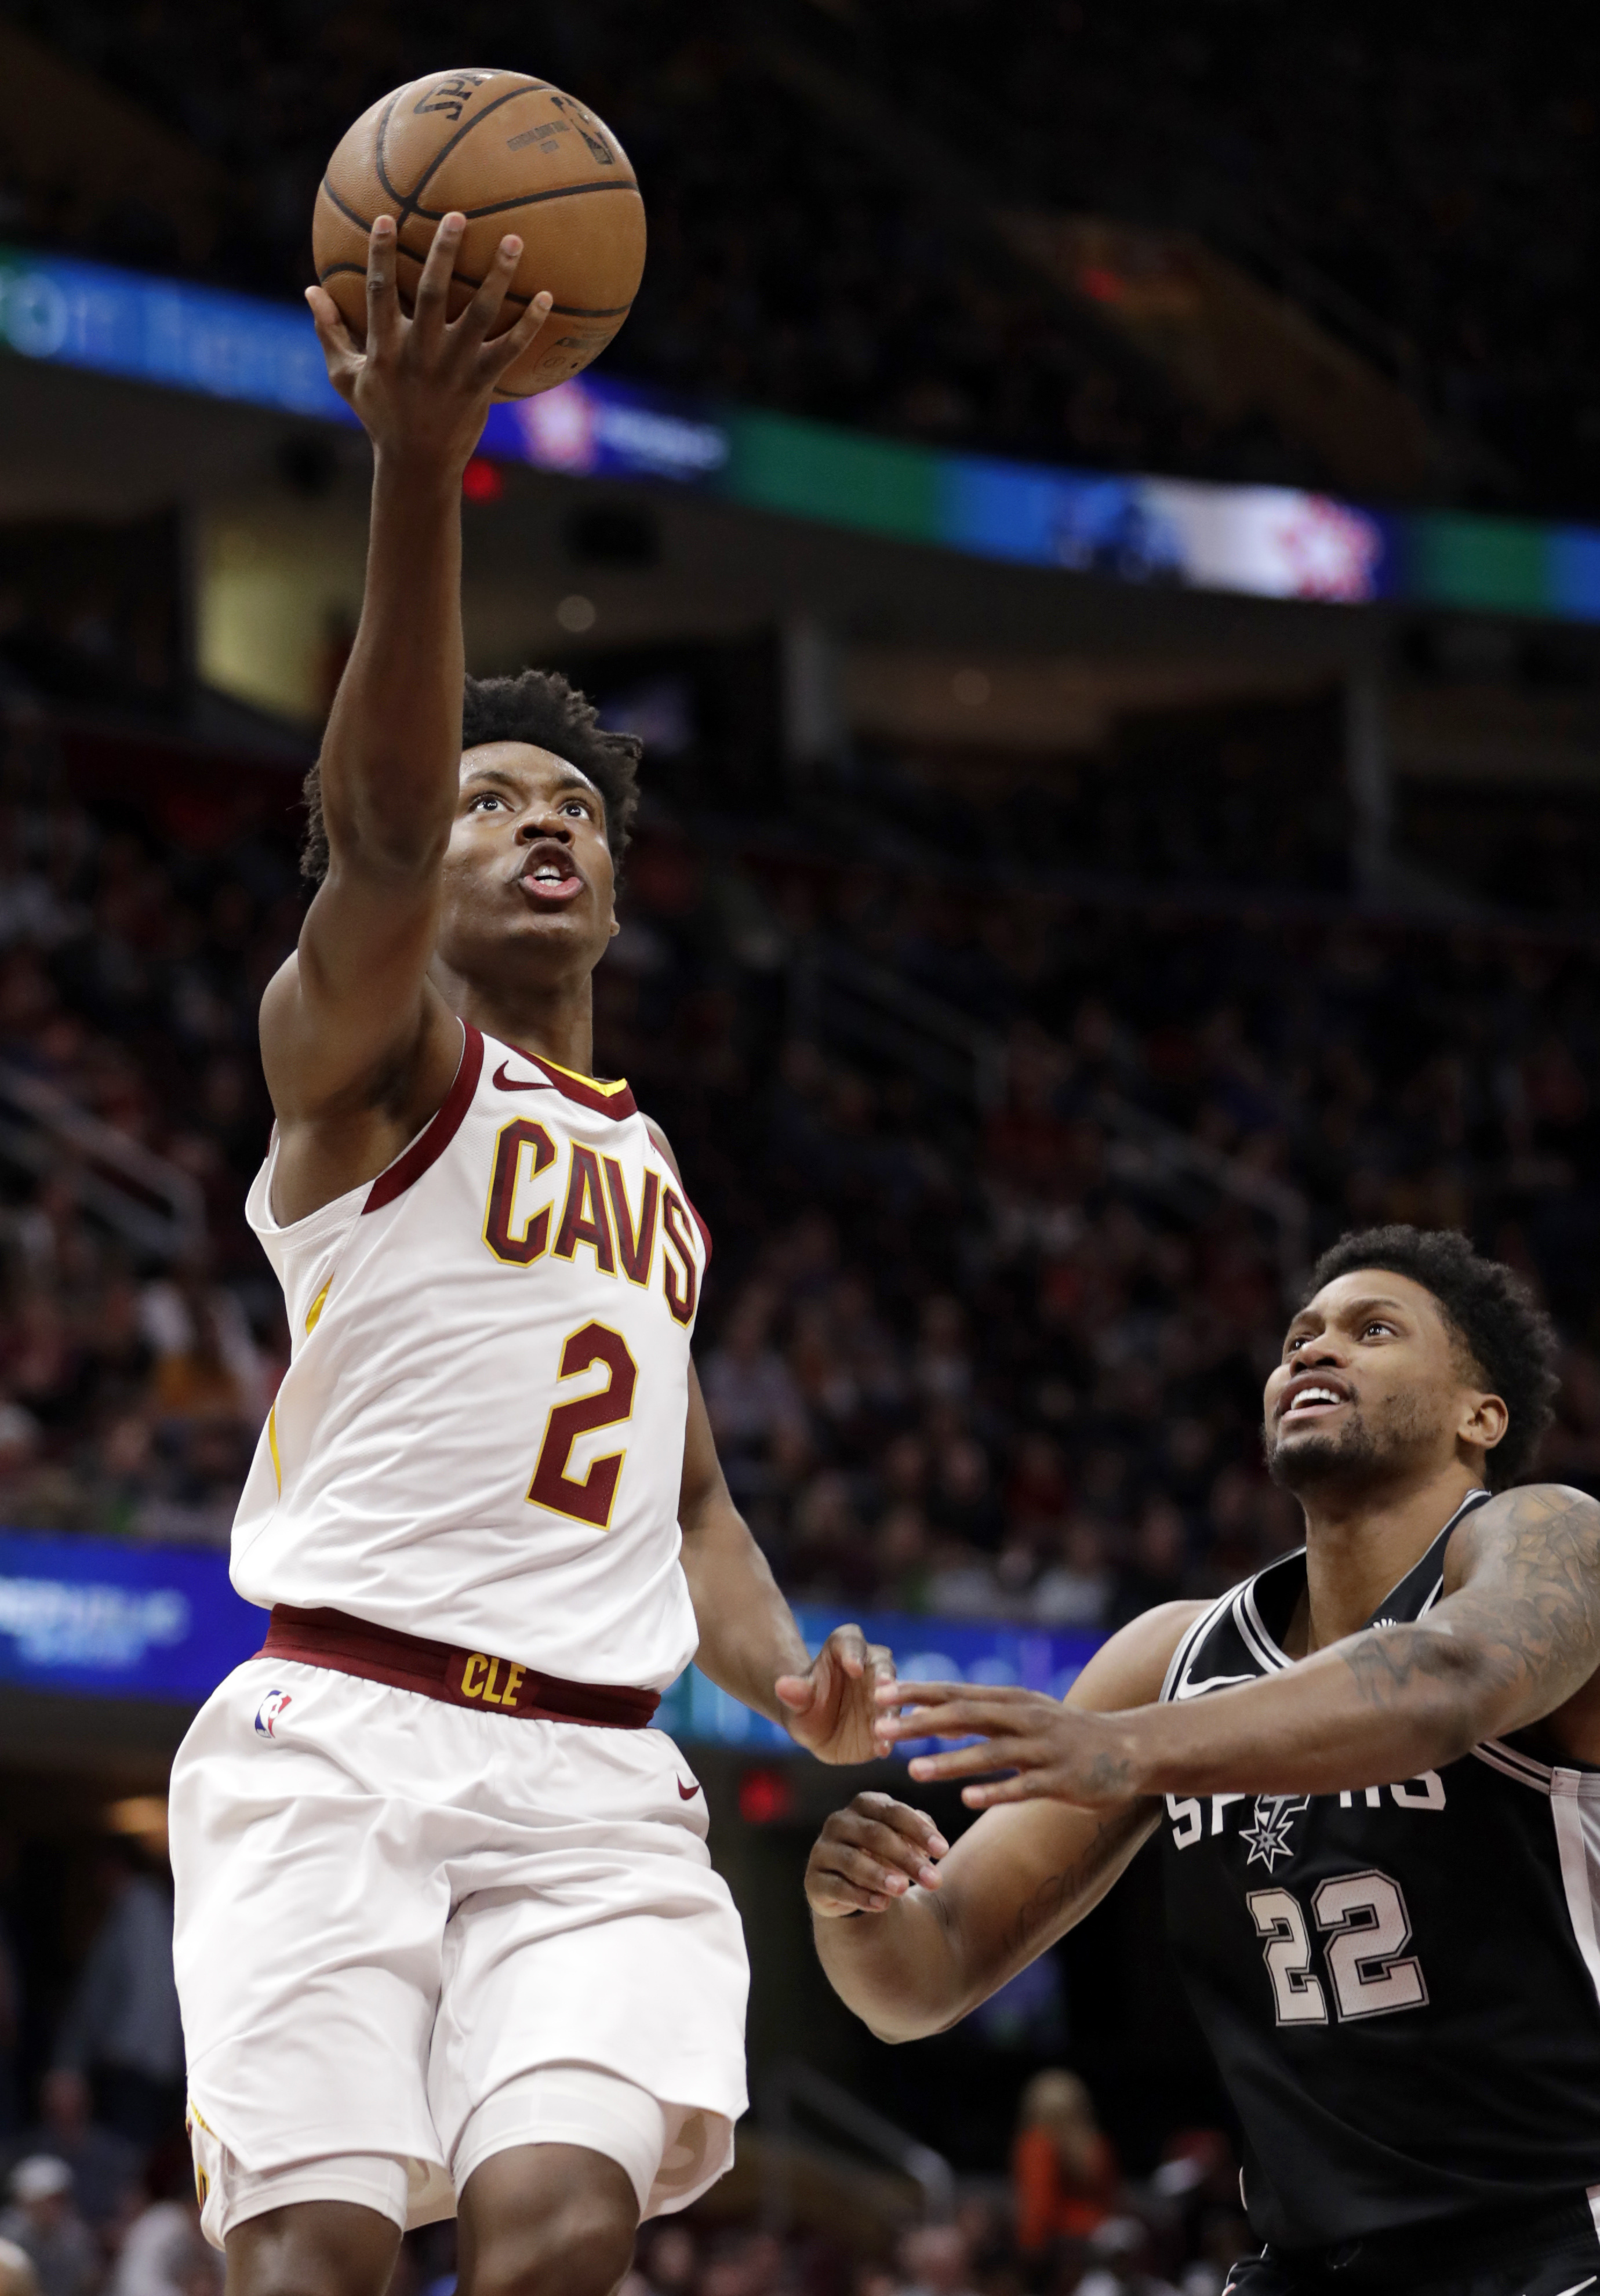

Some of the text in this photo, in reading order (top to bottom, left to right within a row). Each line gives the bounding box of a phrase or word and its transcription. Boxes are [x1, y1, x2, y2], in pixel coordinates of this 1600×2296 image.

[481, 1116, 697, 1328] CAVS
[525, 1318, 639, 1531] 2
[461, 1652, 526, 1706] CLE
[1246, 1868, 1430, 2027] 22
